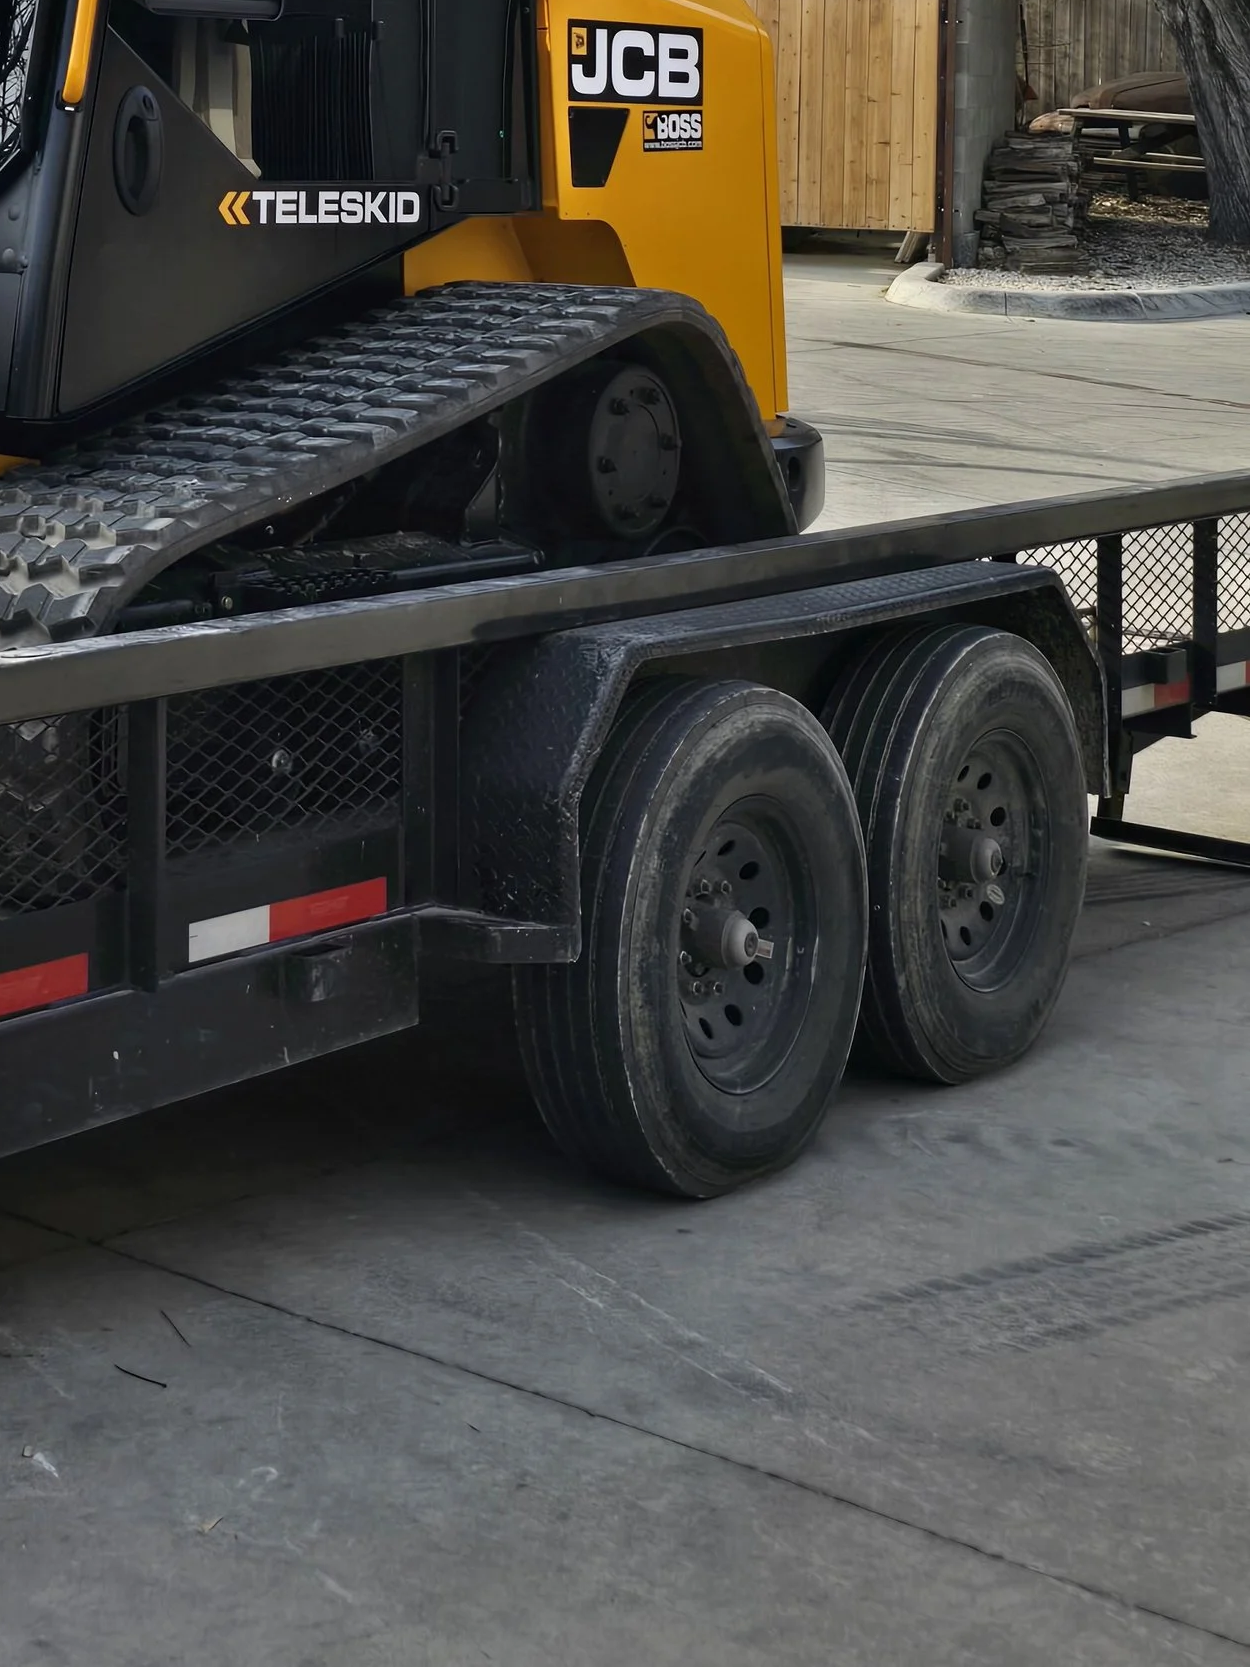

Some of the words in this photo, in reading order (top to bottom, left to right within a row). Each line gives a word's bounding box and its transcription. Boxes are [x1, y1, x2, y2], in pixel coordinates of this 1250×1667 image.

[571, 28, 700, 99] JCB
[656, 113, 702, 140] BOSS
[252, 190, 420, 225] TELESKID
